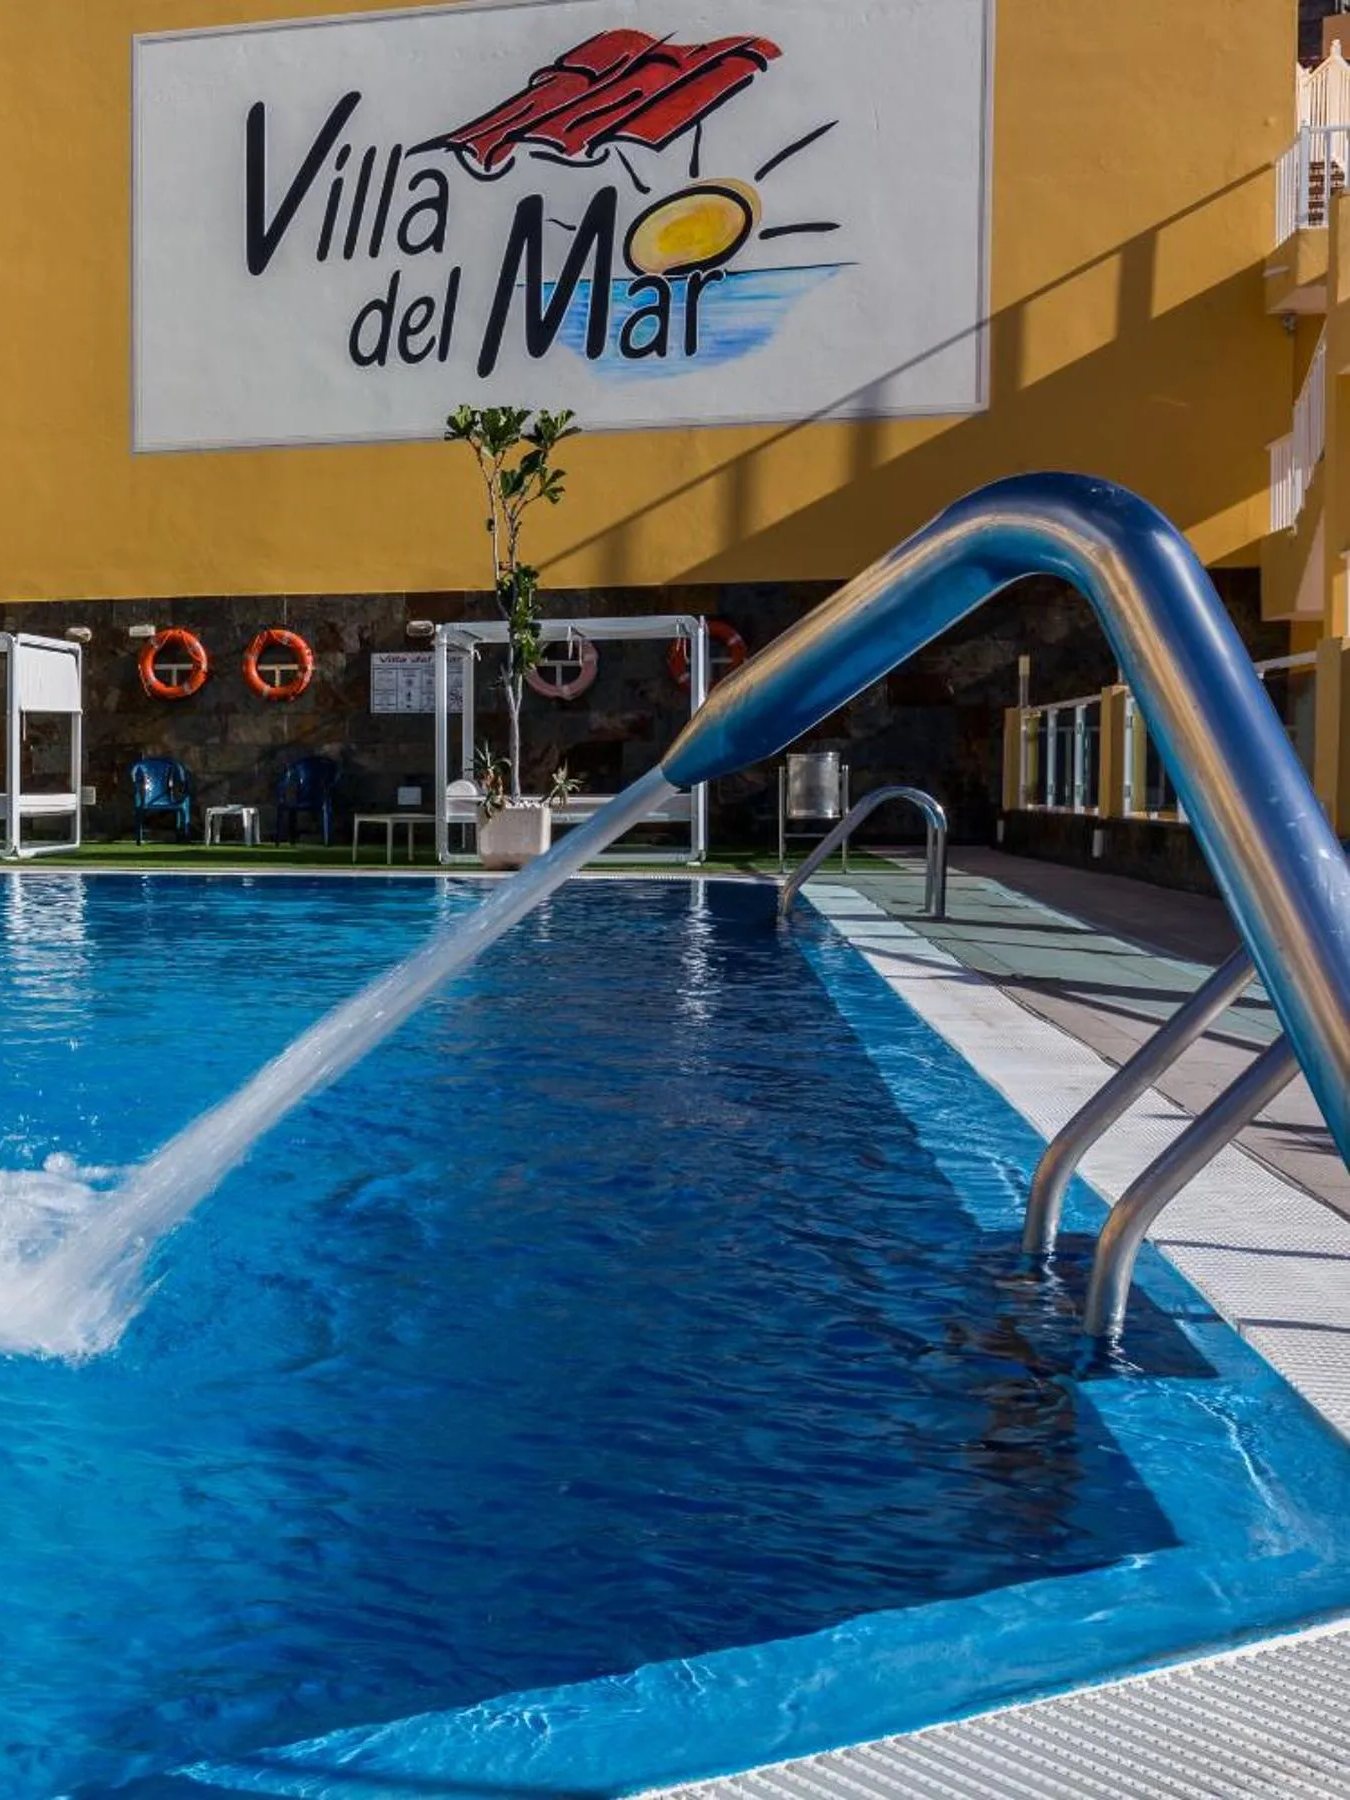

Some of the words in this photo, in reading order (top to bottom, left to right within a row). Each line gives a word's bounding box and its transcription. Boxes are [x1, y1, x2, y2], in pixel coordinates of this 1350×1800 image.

[245, 91, 449, 276] Villa
[348, 266, 461, 366] del
[476, 186, 724, 378] Mar
